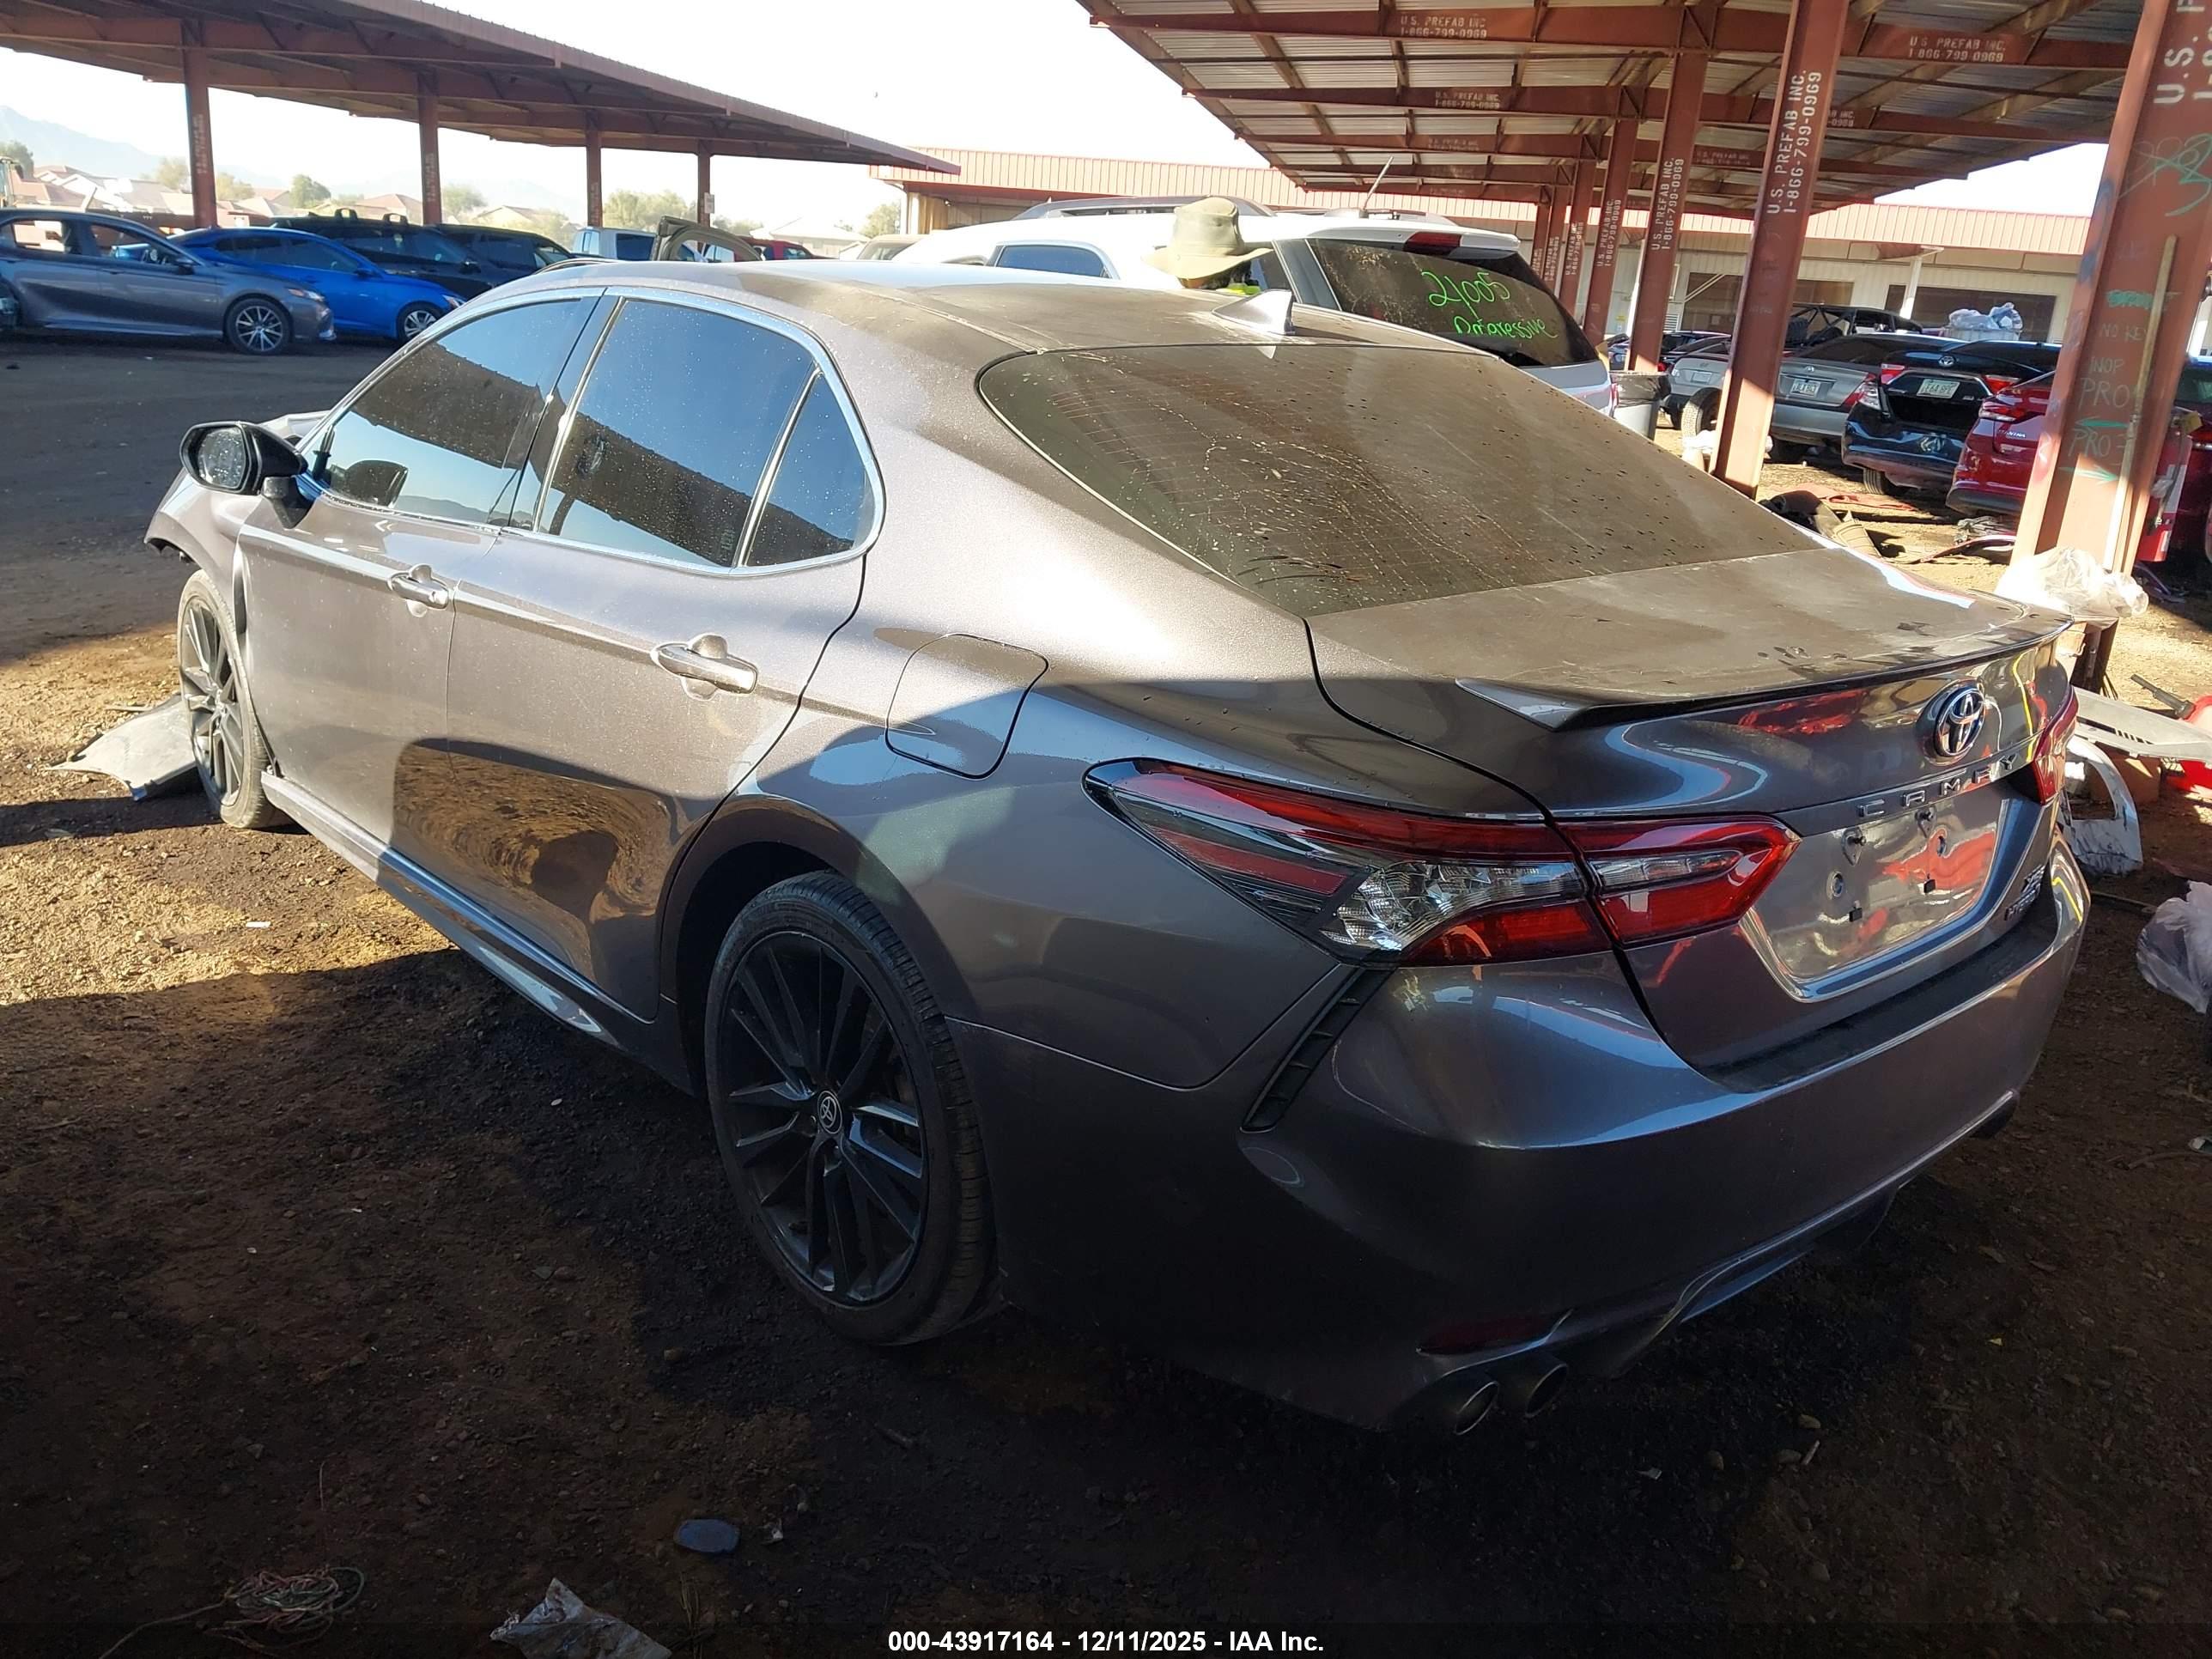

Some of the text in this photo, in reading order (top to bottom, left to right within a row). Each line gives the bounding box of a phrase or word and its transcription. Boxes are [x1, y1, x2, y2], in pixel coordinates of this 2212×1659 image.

[1936, 37, 1981, 50] PREFAB
[2153, 35, 2199, 104] U.S.
[1662, 157, 1674, 178] INC.
[1766, 70, 1807, 214] U.S. PREFAB INC.
[1784, 71, 1821, 213] 1-866-799-0969
[1655, 183, 1670, 224] PREFAB
[1662, 158, 1684, 250] 1-866-799-0969
[1857, 754, 2016, 817] CAMRY
